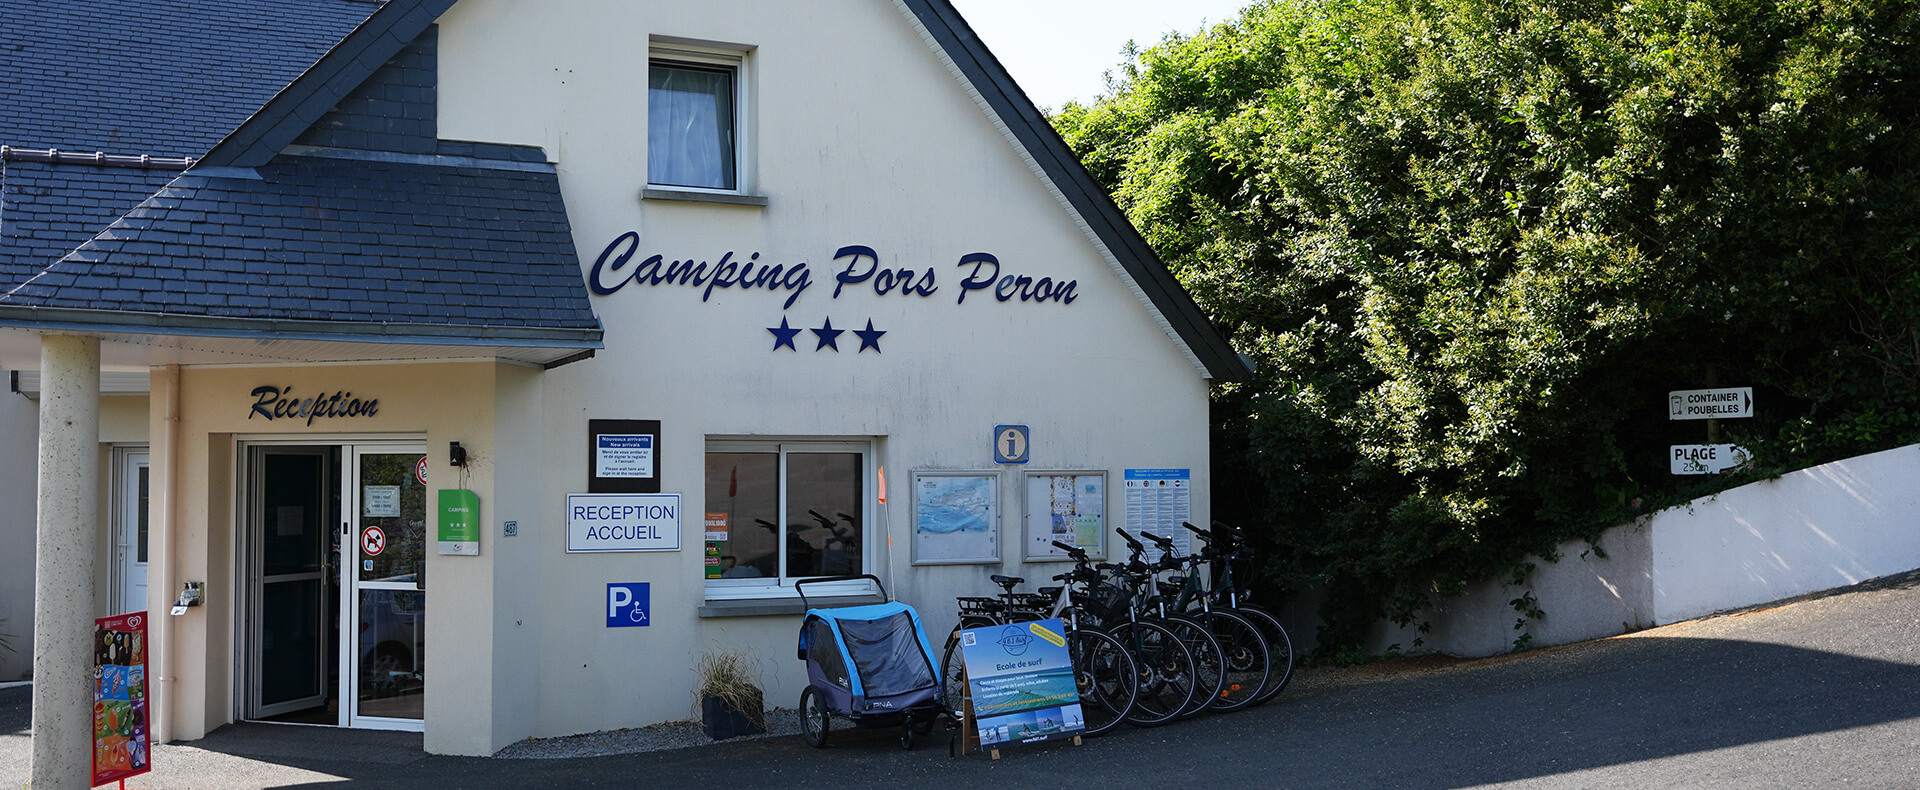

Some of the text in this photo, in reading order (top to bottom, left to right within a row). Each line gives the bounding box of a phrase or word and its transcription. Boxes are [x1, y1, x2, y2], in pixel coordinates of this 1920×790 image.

[589, 230, 1079, 310] Camping Pors Peron
[1688, 392, 1738, 403] CONTAINER
[248, 385, 379, 427] Réception
[1687, 404, 1739, 415] POUBELLES
[1674, 448, 1716, 461] PLAGE
[574, 505, 674, 520] RECEPTION
[505, 523, 516, 534] 487
[586, 525, 662, 540] ACCUEIL
[609, 586, 632, 618] P
[996, 657, 1042, 671] Ecole de surf
